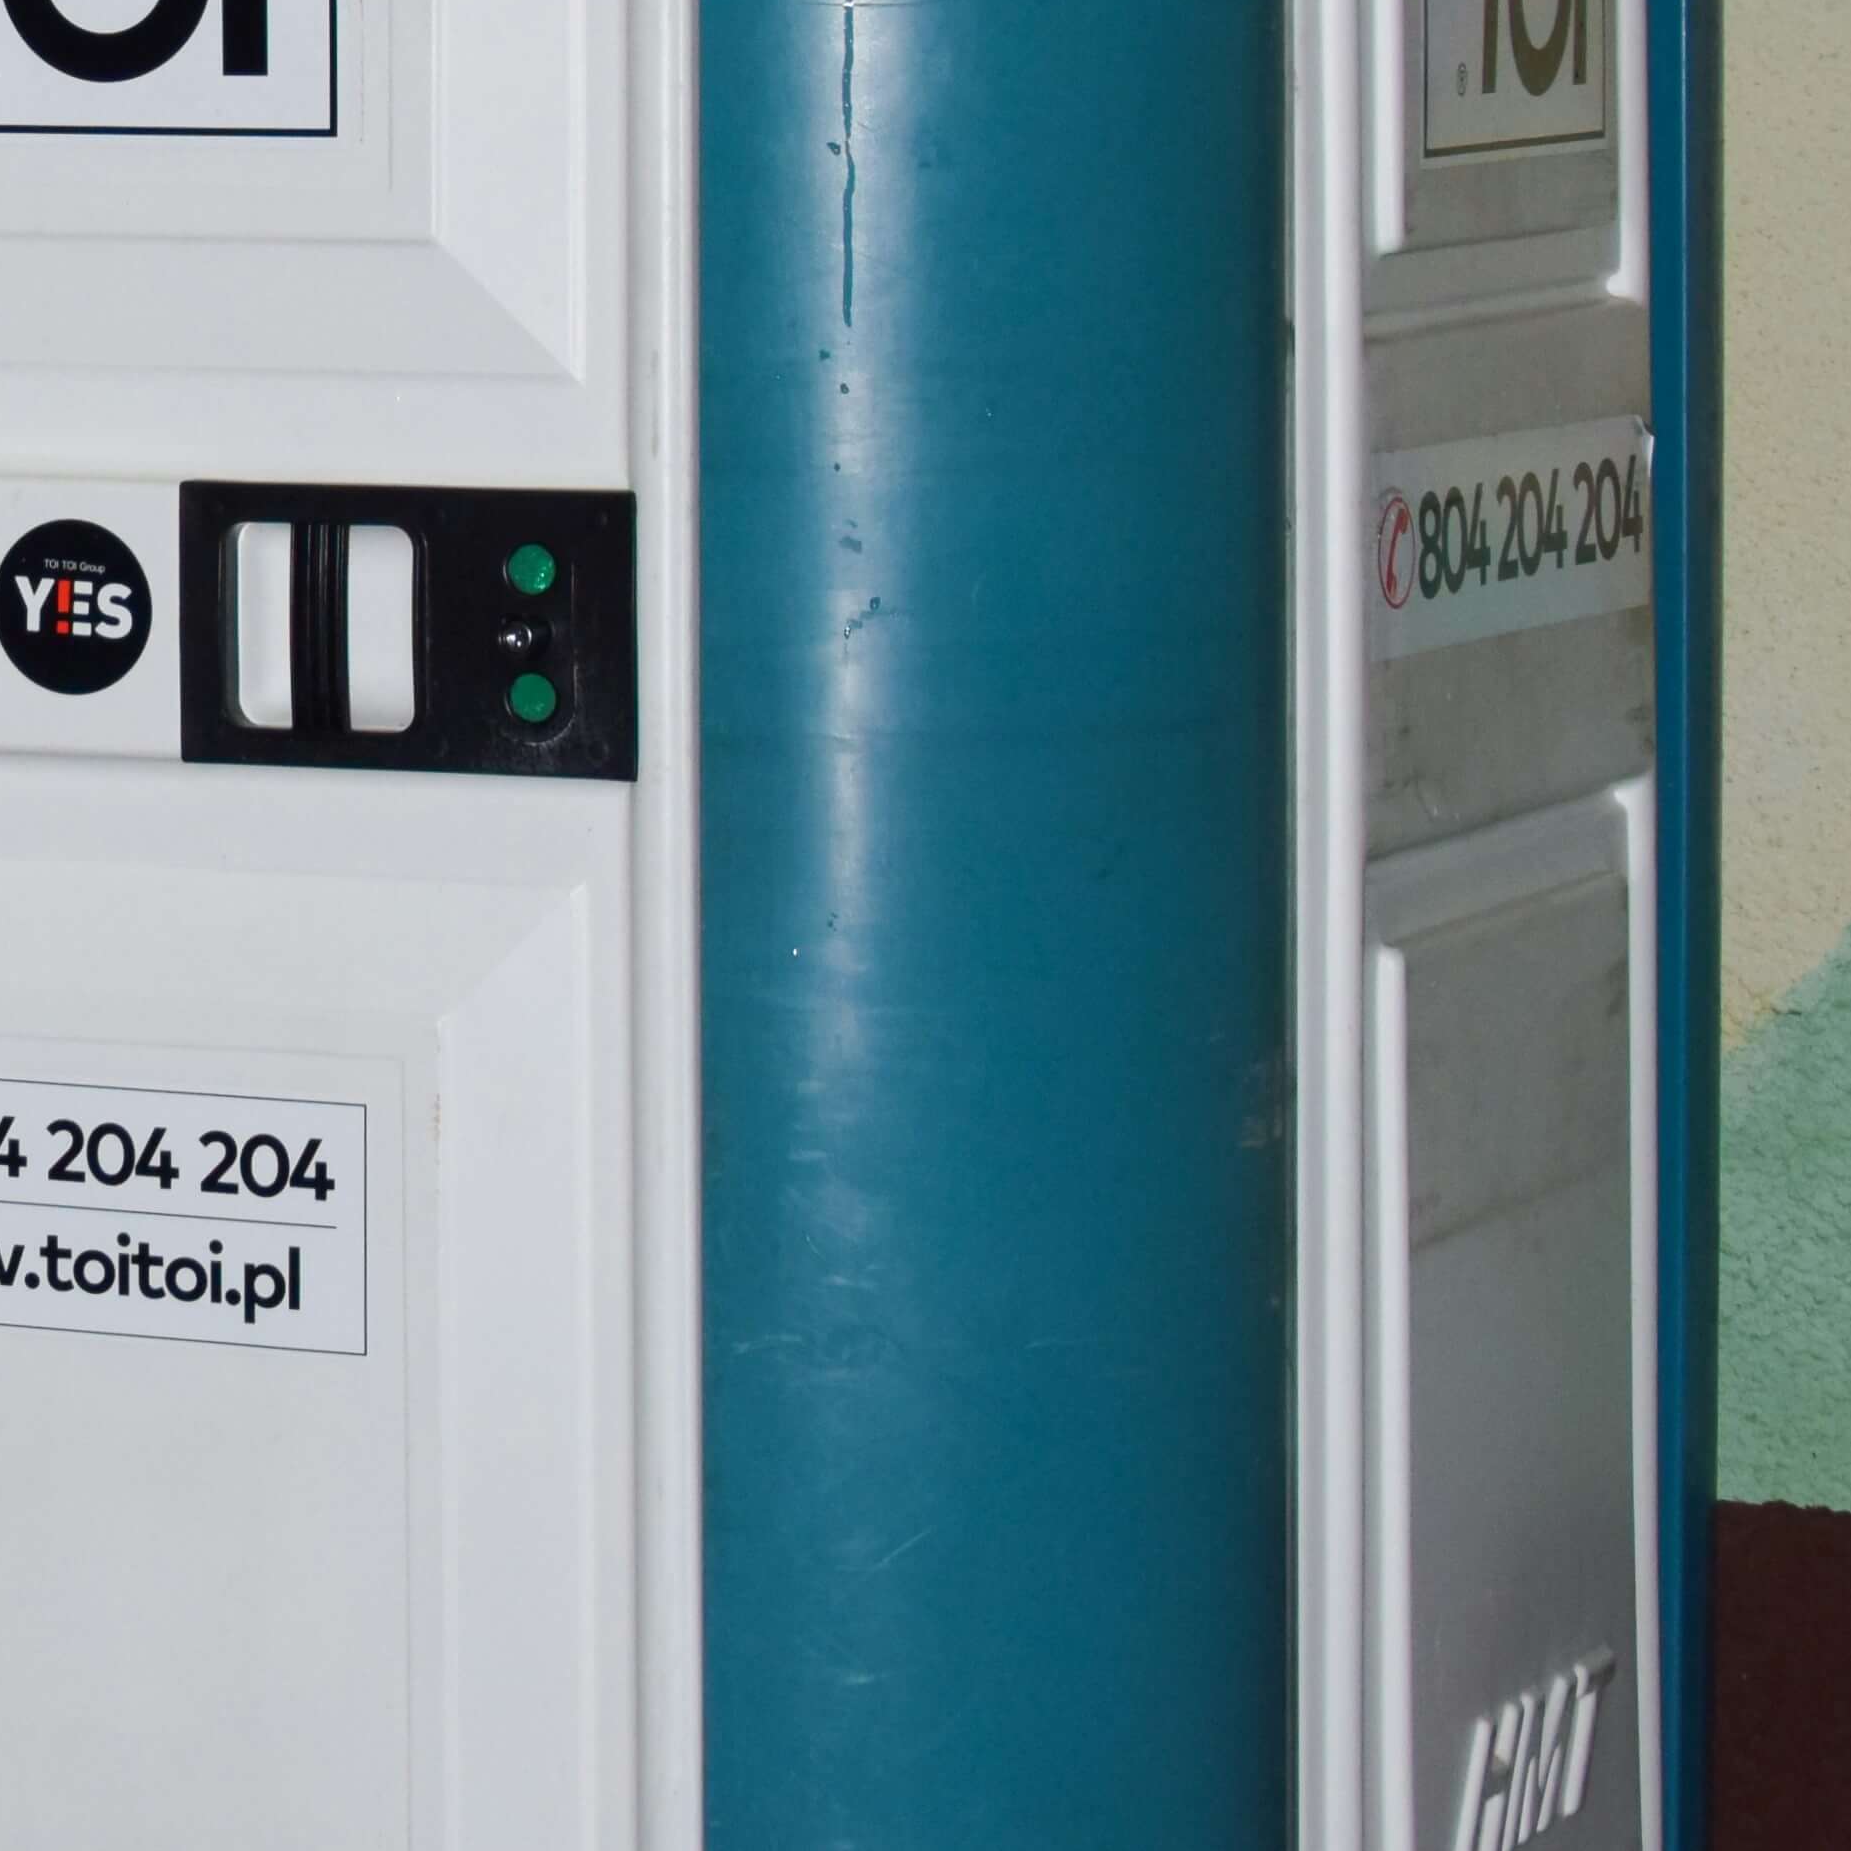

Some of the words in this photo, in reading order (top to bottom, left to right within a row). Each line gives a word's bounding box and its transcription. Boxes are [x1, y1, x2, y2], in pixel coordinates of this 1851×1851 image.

[79, 561, 106, 575] Group
[1418, 482, 1491, 599] 804
[1496, 468, 1568, 582] 204
[1573, 454, 1644, 566] 204
[46, 1118, 179, 1190] 204
[198, 1130, 336, 1202] 204
